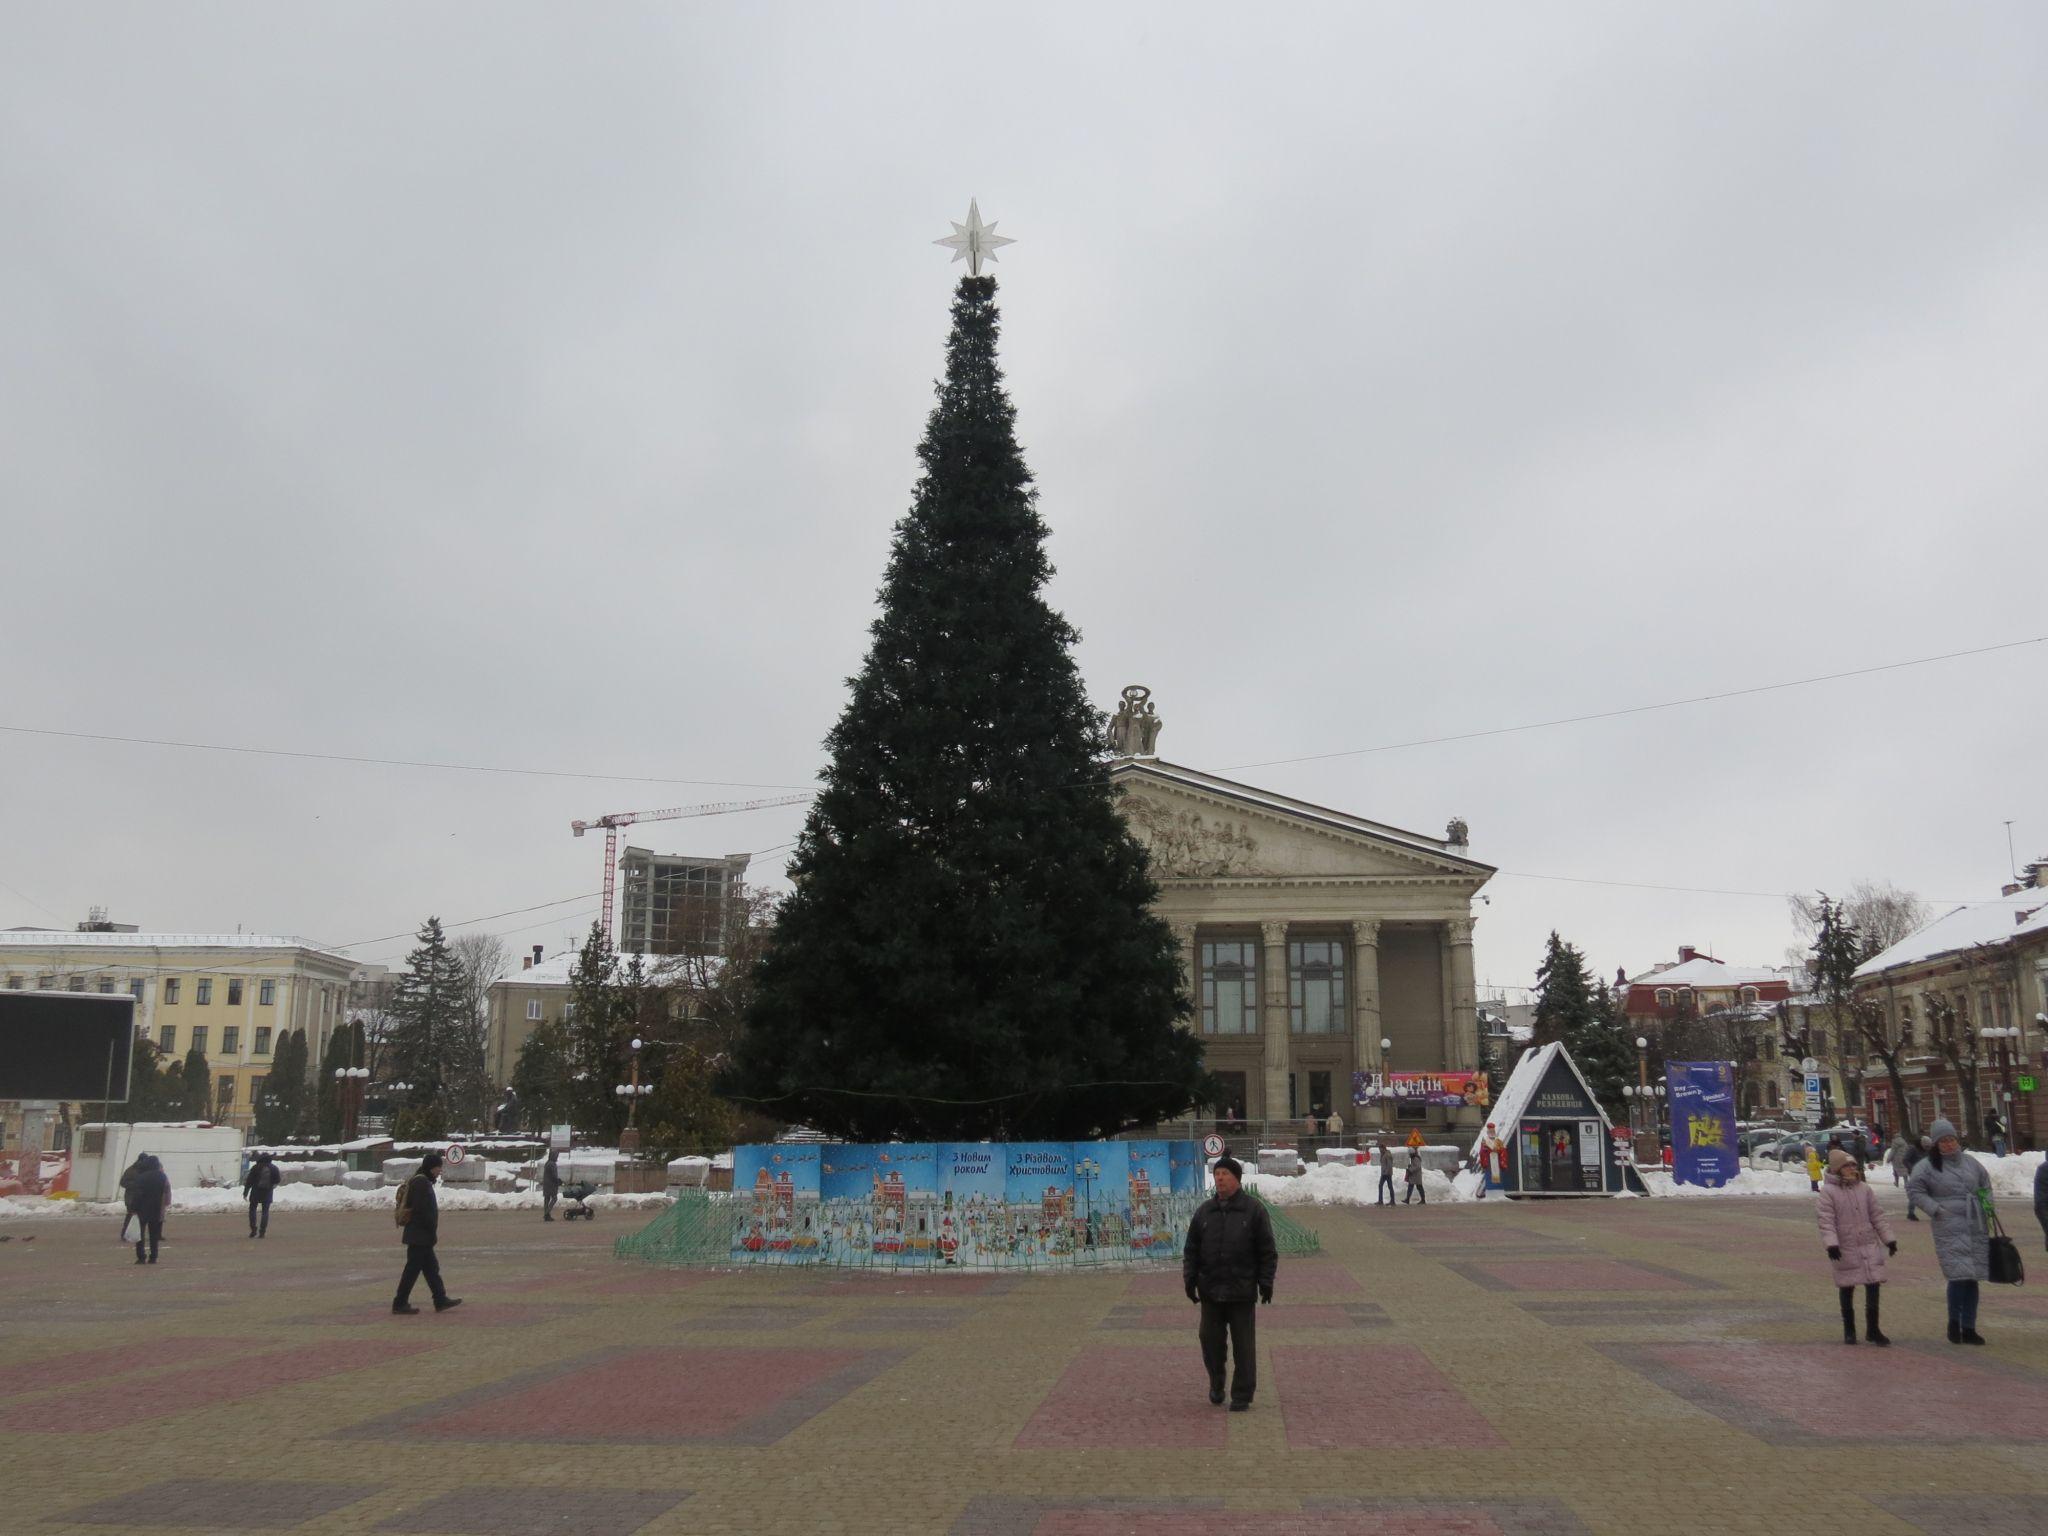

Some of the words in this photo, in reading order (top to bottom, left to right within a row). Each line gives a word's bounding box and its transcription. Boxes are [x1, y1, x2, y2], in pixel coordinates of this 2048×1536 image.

[952, 1152, 959, 1162] З
[961, 1151, 992, 1162] Новим
[1016, 1153, 1023, 1164] З
[1025, 1152, 1063, 1164] Різдвом
[954, 1163, 988, 1176] роком!
[1009, 1164, 1068, 1177] Христовим!
